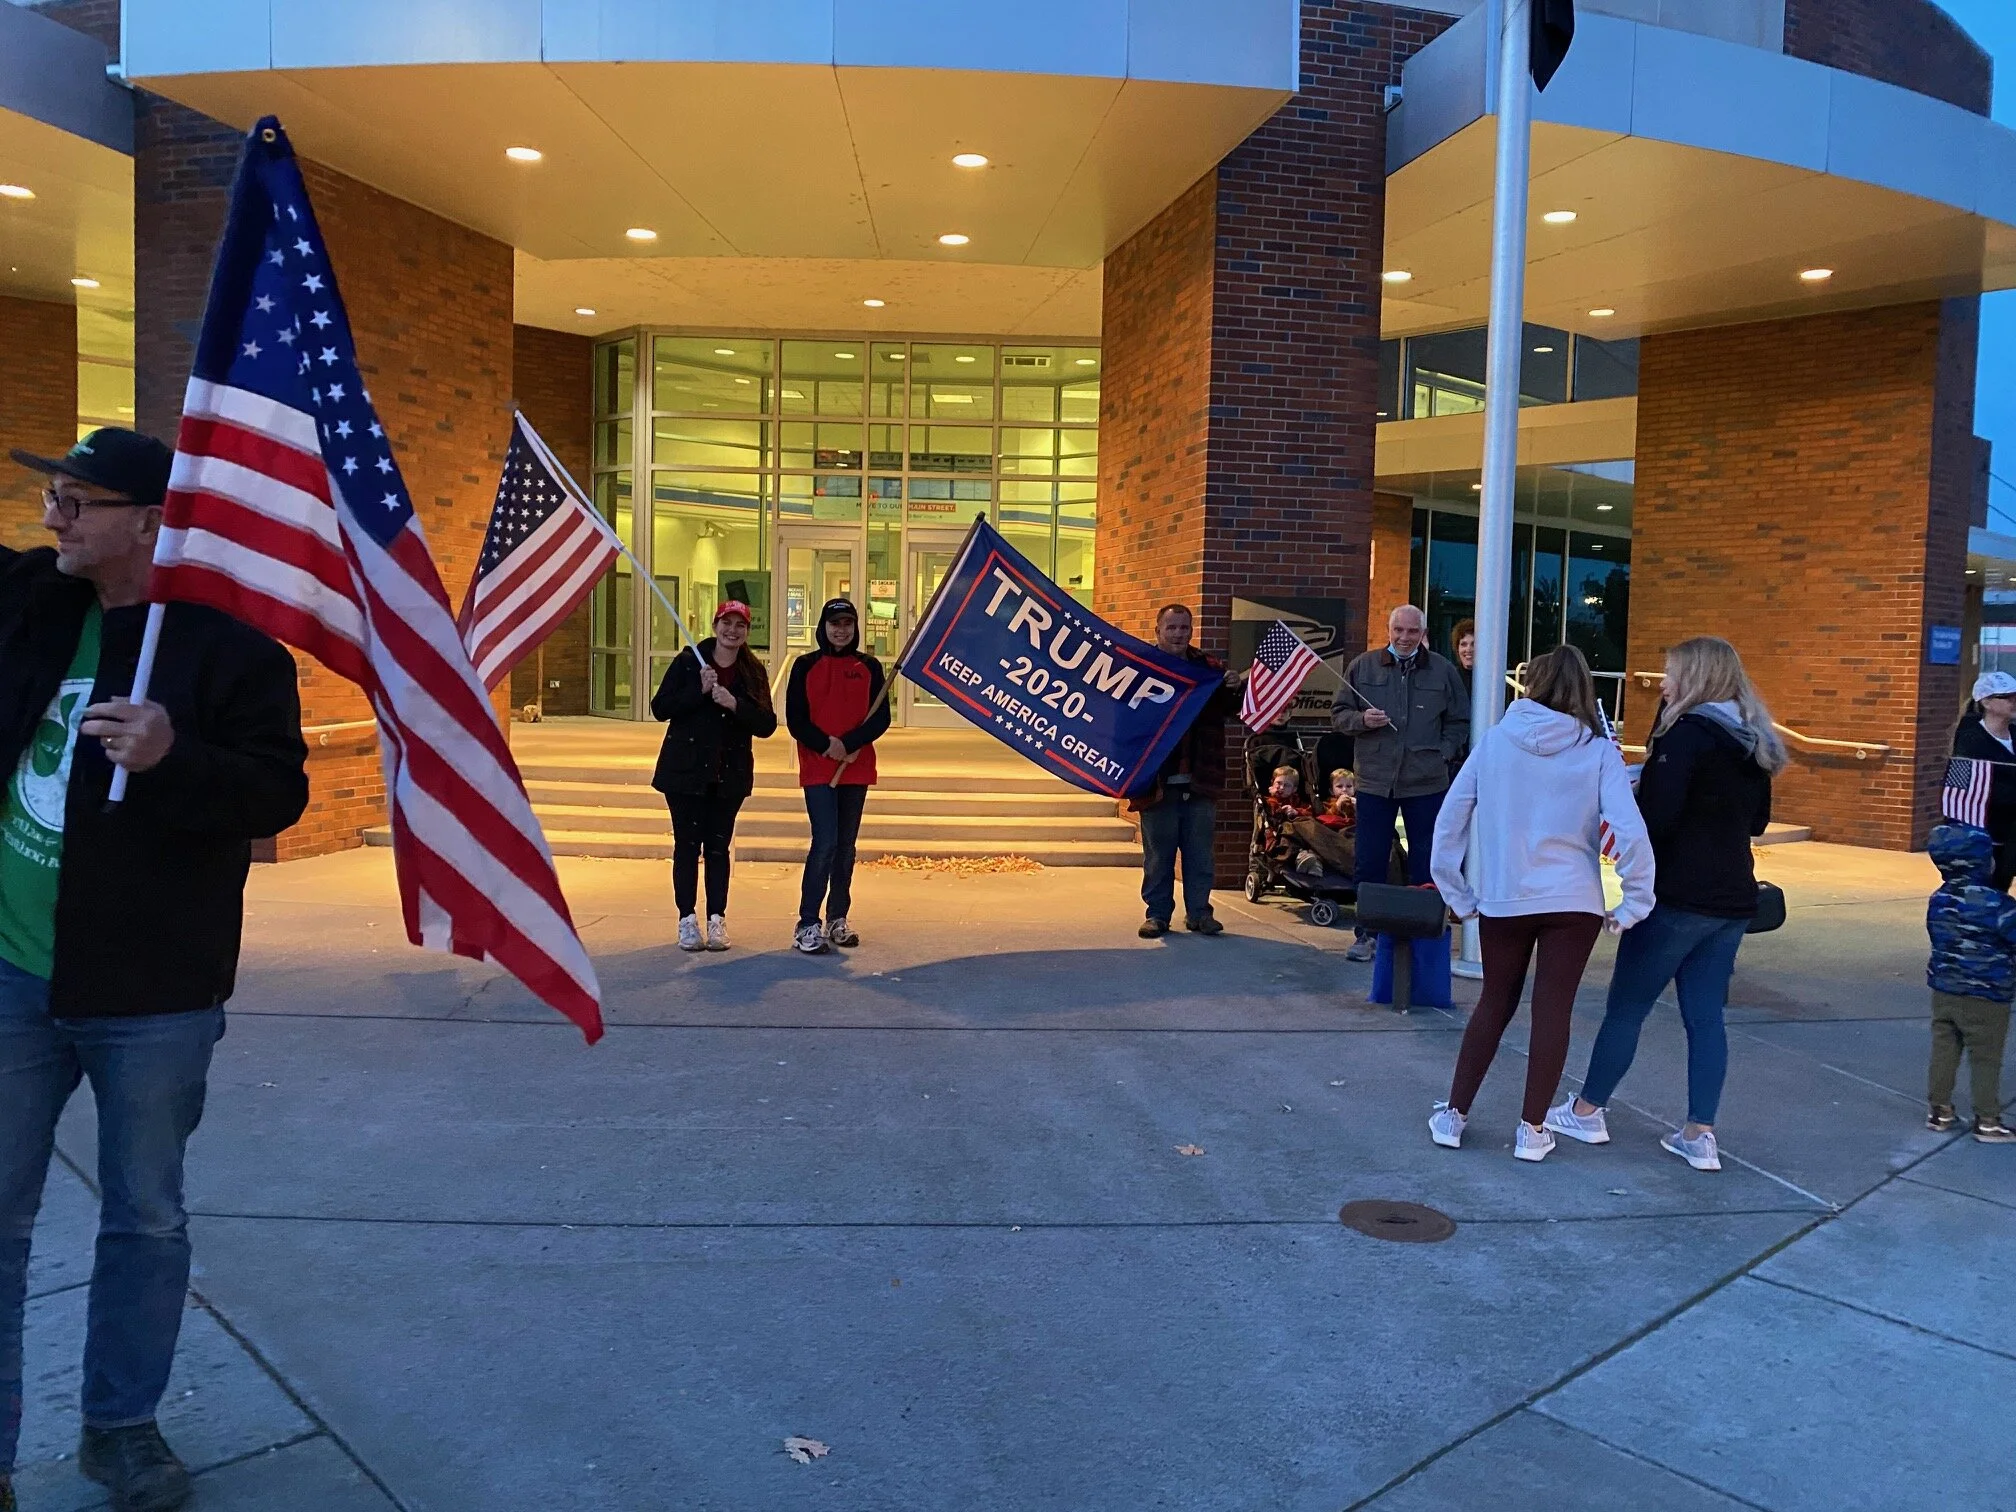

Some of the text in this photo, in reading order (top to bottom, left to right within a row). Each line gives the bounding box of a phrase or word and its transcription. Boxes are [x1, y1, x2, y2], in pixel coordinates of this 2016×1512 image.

[984, 567, 1176, 711] TRUMP
[1290, 696, 1332, 709] Office
[939, 652, 1124, 781] KEEP AMERICA GREAT!
